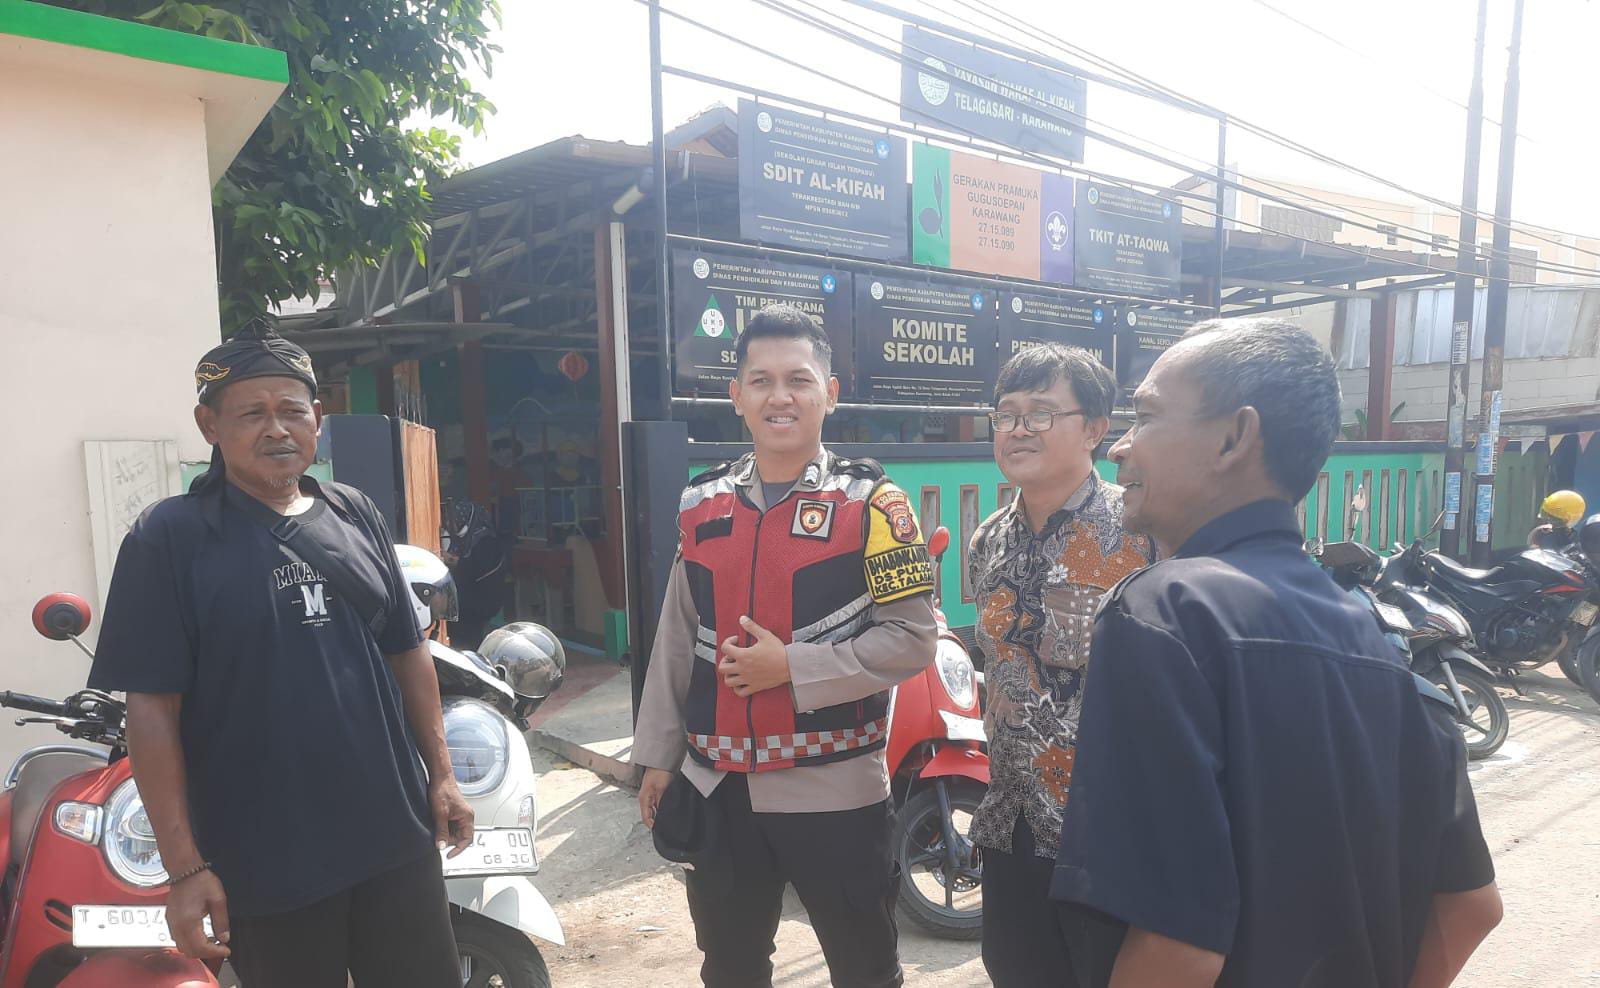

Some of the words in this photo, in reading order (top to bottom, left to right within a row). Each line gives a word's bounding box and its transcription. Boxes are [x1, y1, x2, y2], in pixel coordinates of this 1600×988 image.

[954, 93, 1014, 121] TELAGASARI
[763, 162, 804, 185] SDIT
[809, 171, 886, 201] AL-KIFAH
[953, 174, 996, 191] GERAKAN
[997, 183, 1039, 201] PRAMUKA
[967, 192, 1025, 212] GUGUSDEPAN
[972, 207, 1020, 224] KARAWANG
[978, 222, 1015, 237] 27.15.089
[978, 236, 1015, 251] 27.15.090
[1088, 228, 1115, 243] TKIT
[1117, 233, 1170, 254] AT-TAQWA
[713, 263, 752, 273] PEMERINTAH
[753, 268, 787, 277] KABUPATEN
[787, 272, 819, 281] KARAWANG
[713, 272, 732, 280] DINAS
[732, 275, 769, 284] PENDIDIKAN
[735, 295, 757, 307] TIM
[892, 318, 967, 343] KOMITE
[883, 341, 974, 366] SEKOLAH
[273, 562, 328, 590] MIA
[301, 583, 327, 616] M
[78, 909, 90, 925] T
